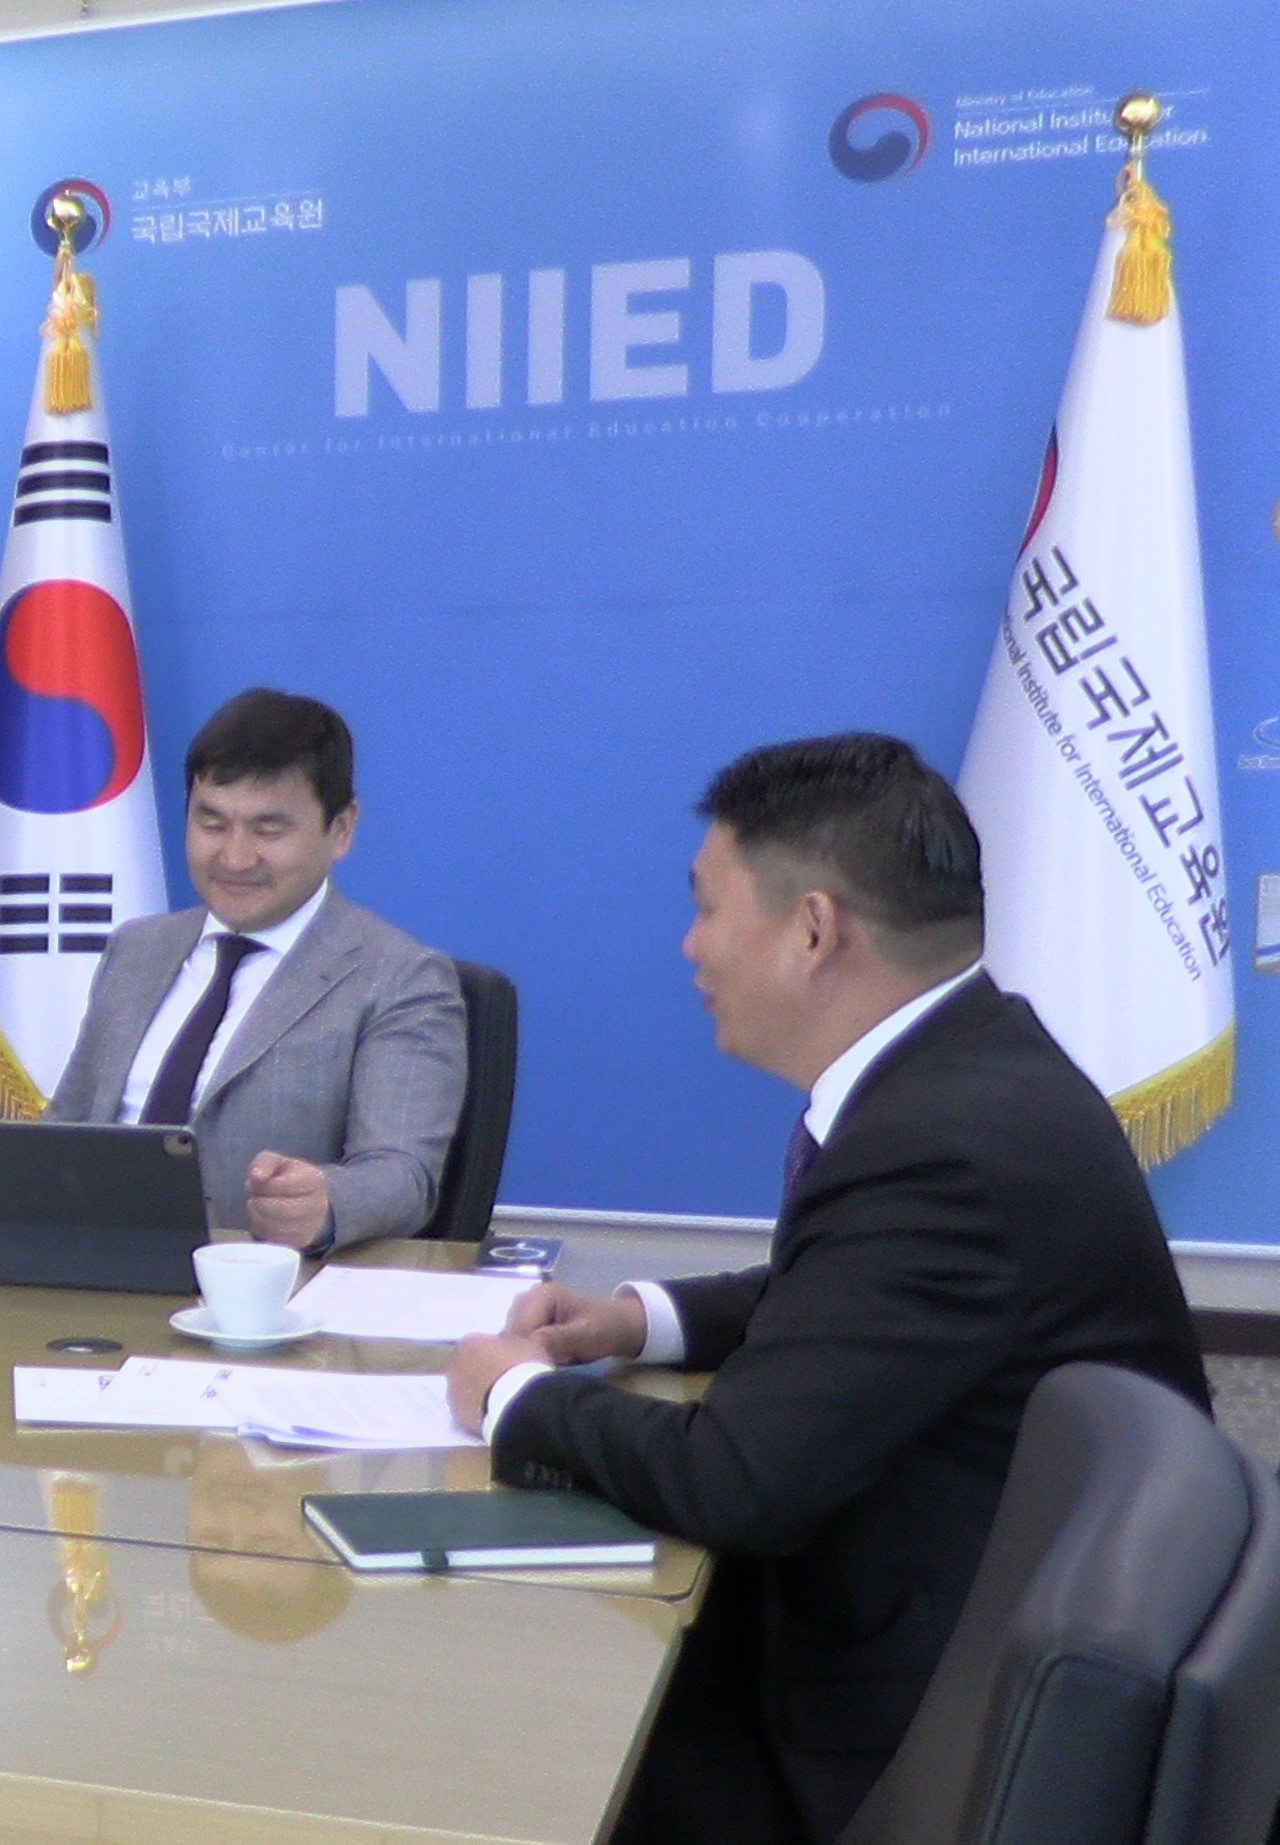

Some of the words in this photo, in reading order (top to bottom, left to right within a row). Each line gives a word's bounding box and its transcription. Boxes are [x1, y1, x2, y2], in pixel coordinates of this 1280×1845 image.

[954, 110, 1044, 139] National
[953, 134, 1089, 167] International
[132, 176, 191, 200] 교육부
[131, 199, 323, 245] 국립국제교육원
[334, 249, 826, 418] NIIED
[1021, 544, 1231, 967] 국립국제교육원
[1017, 660, 1063, 737] Institute
[1055, 731, 1082, 763] for
[1072, 760, 1159, 885] International
[1145, 882, 1202, 983] Education
